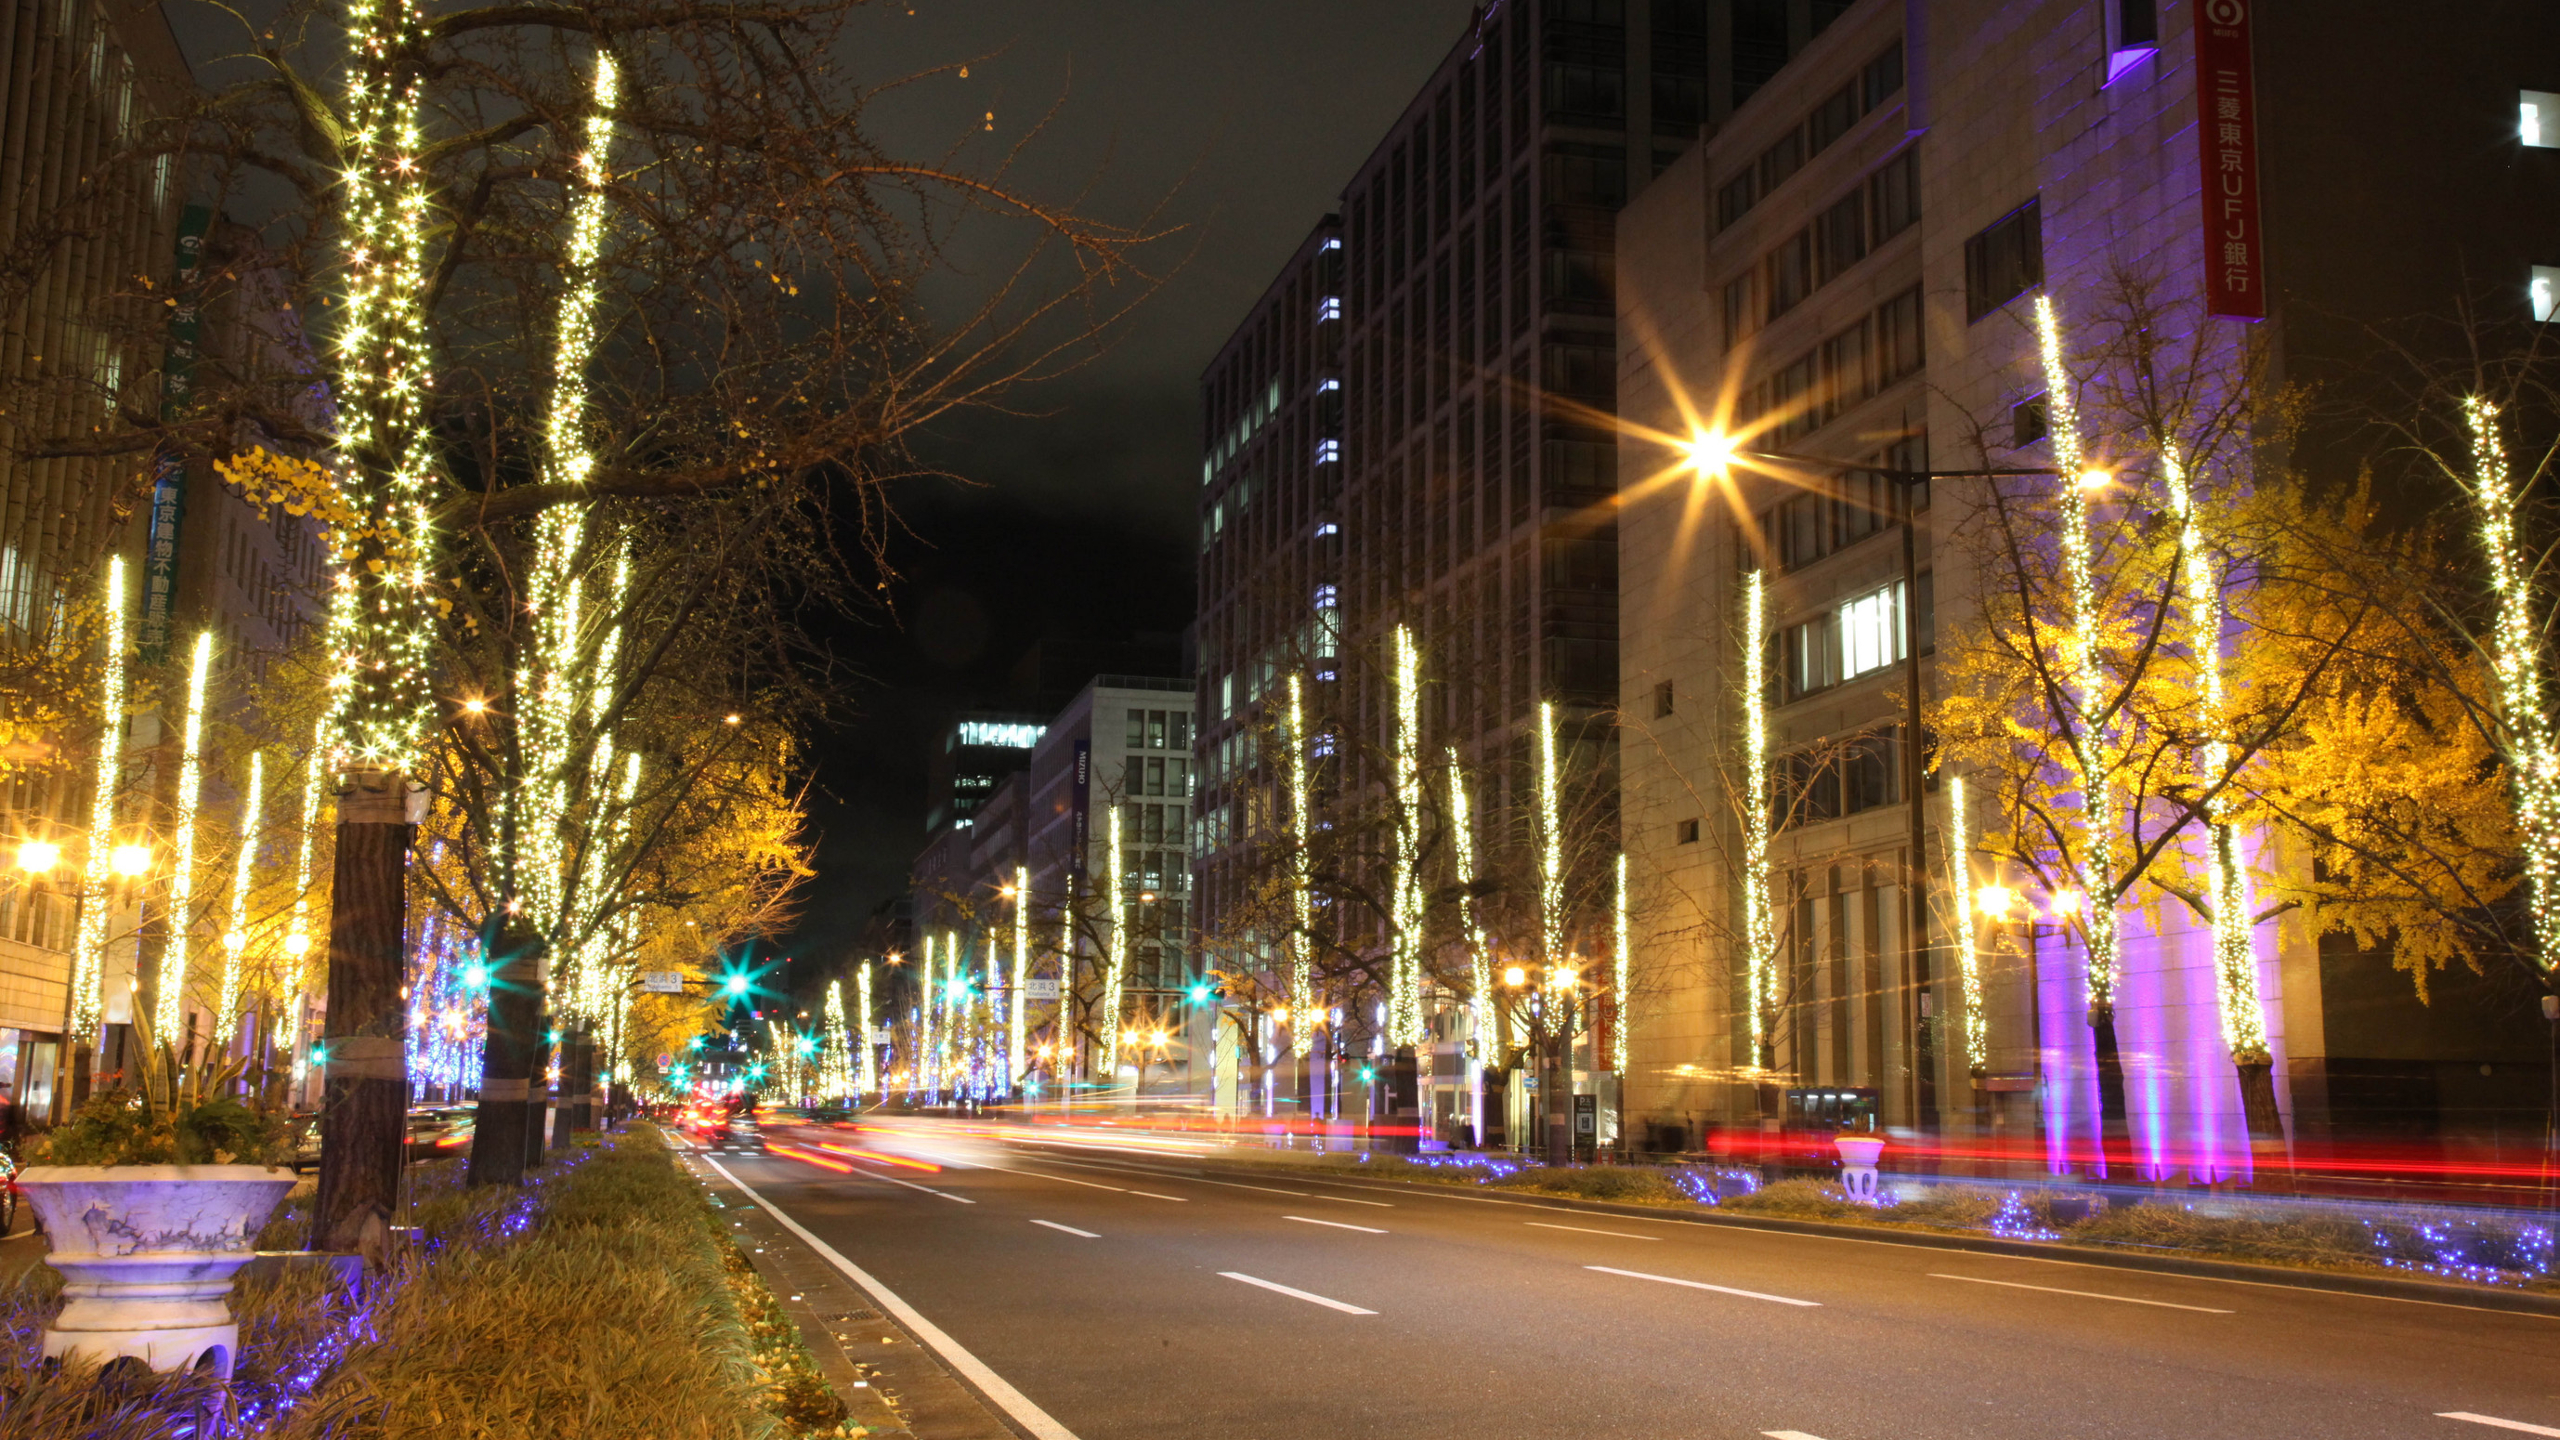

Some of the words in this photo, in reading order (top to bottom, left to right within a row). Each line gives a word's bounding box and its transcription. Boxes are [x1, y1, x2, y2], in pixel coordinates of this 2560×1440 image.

[2212, 28, 2239, 38] MUFG
[2216, 70, 2250, 293] 三菱東京UFJ銀行
[1078, 750, 1087, 785] MIZUHO
[671, 974, 677, 984] 3
[1049, 982, 1055, 991] 3
